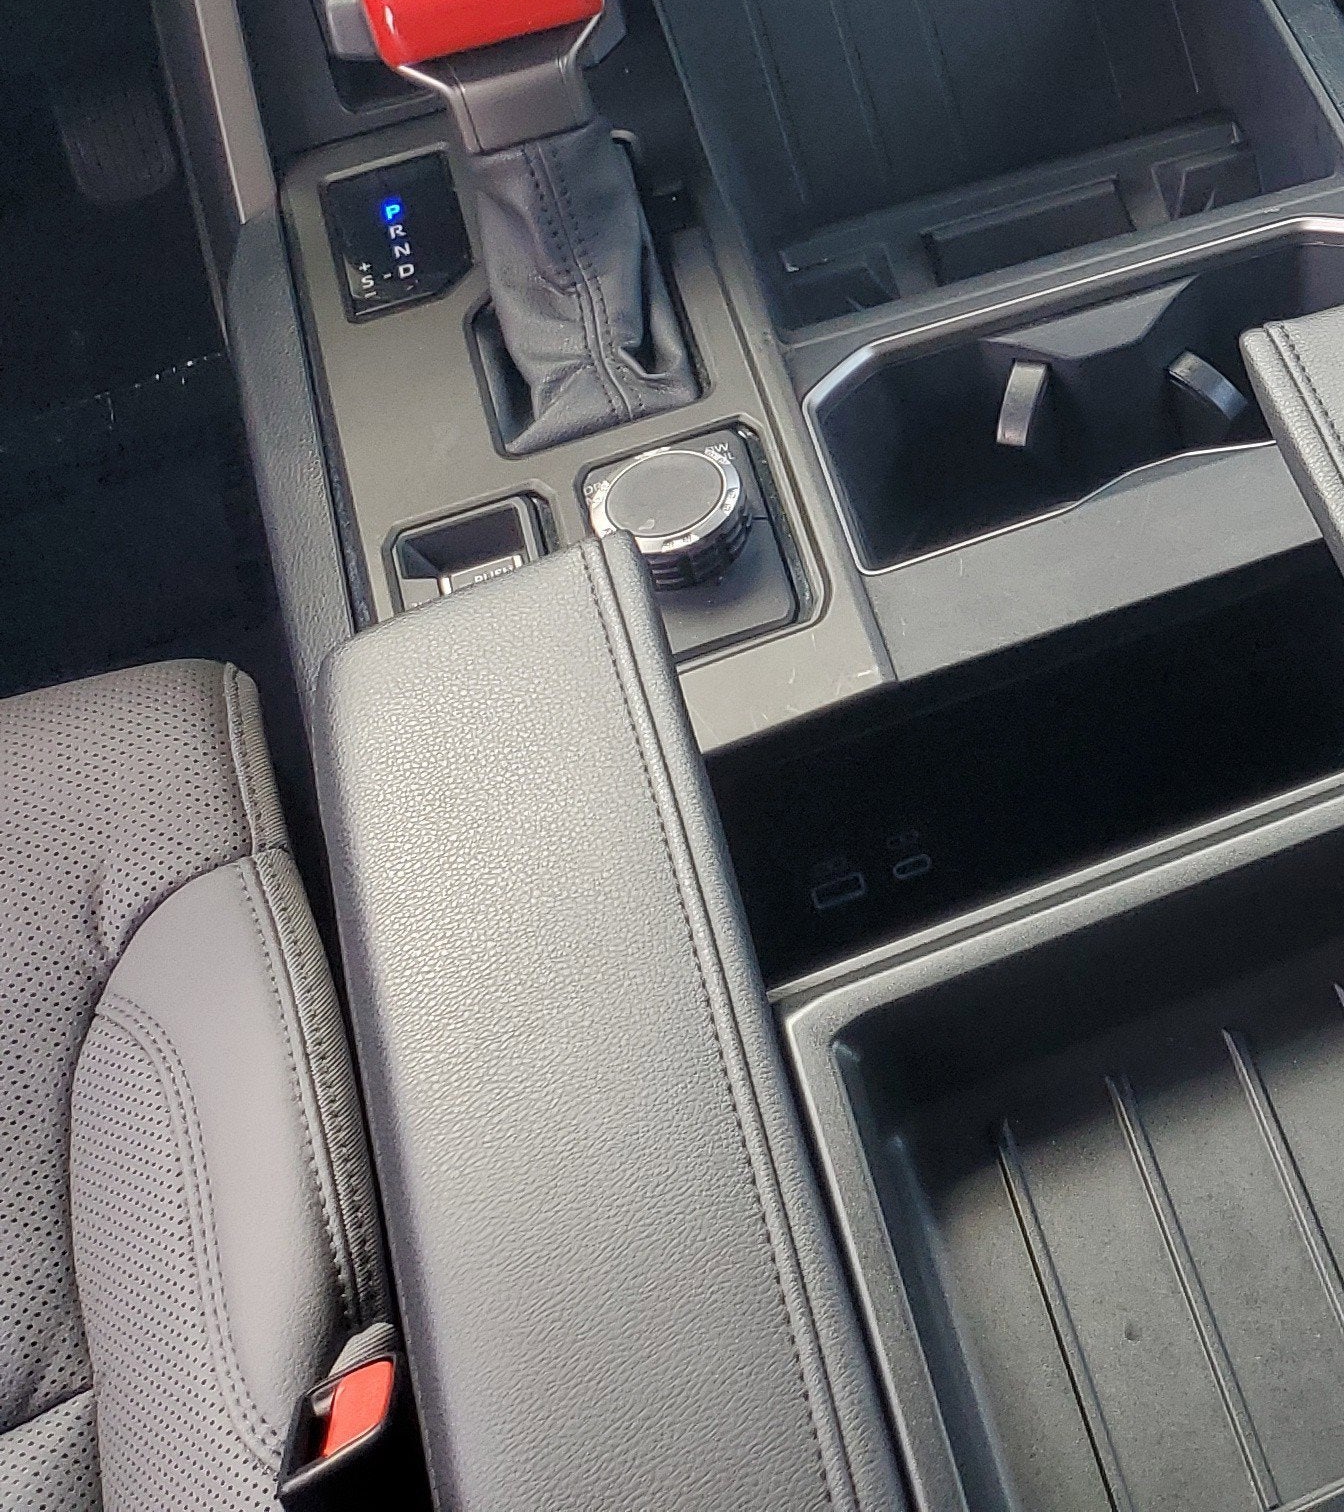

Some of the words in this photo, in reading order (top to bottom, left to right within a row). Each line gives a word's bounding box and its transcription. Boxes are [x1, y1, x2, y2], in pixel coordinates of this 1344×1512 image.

[385, 203, 401, 221] P
[389, 223, 407, 240] R
[393, 241, 411, 259] N
[397, 263, 415, 279] D
